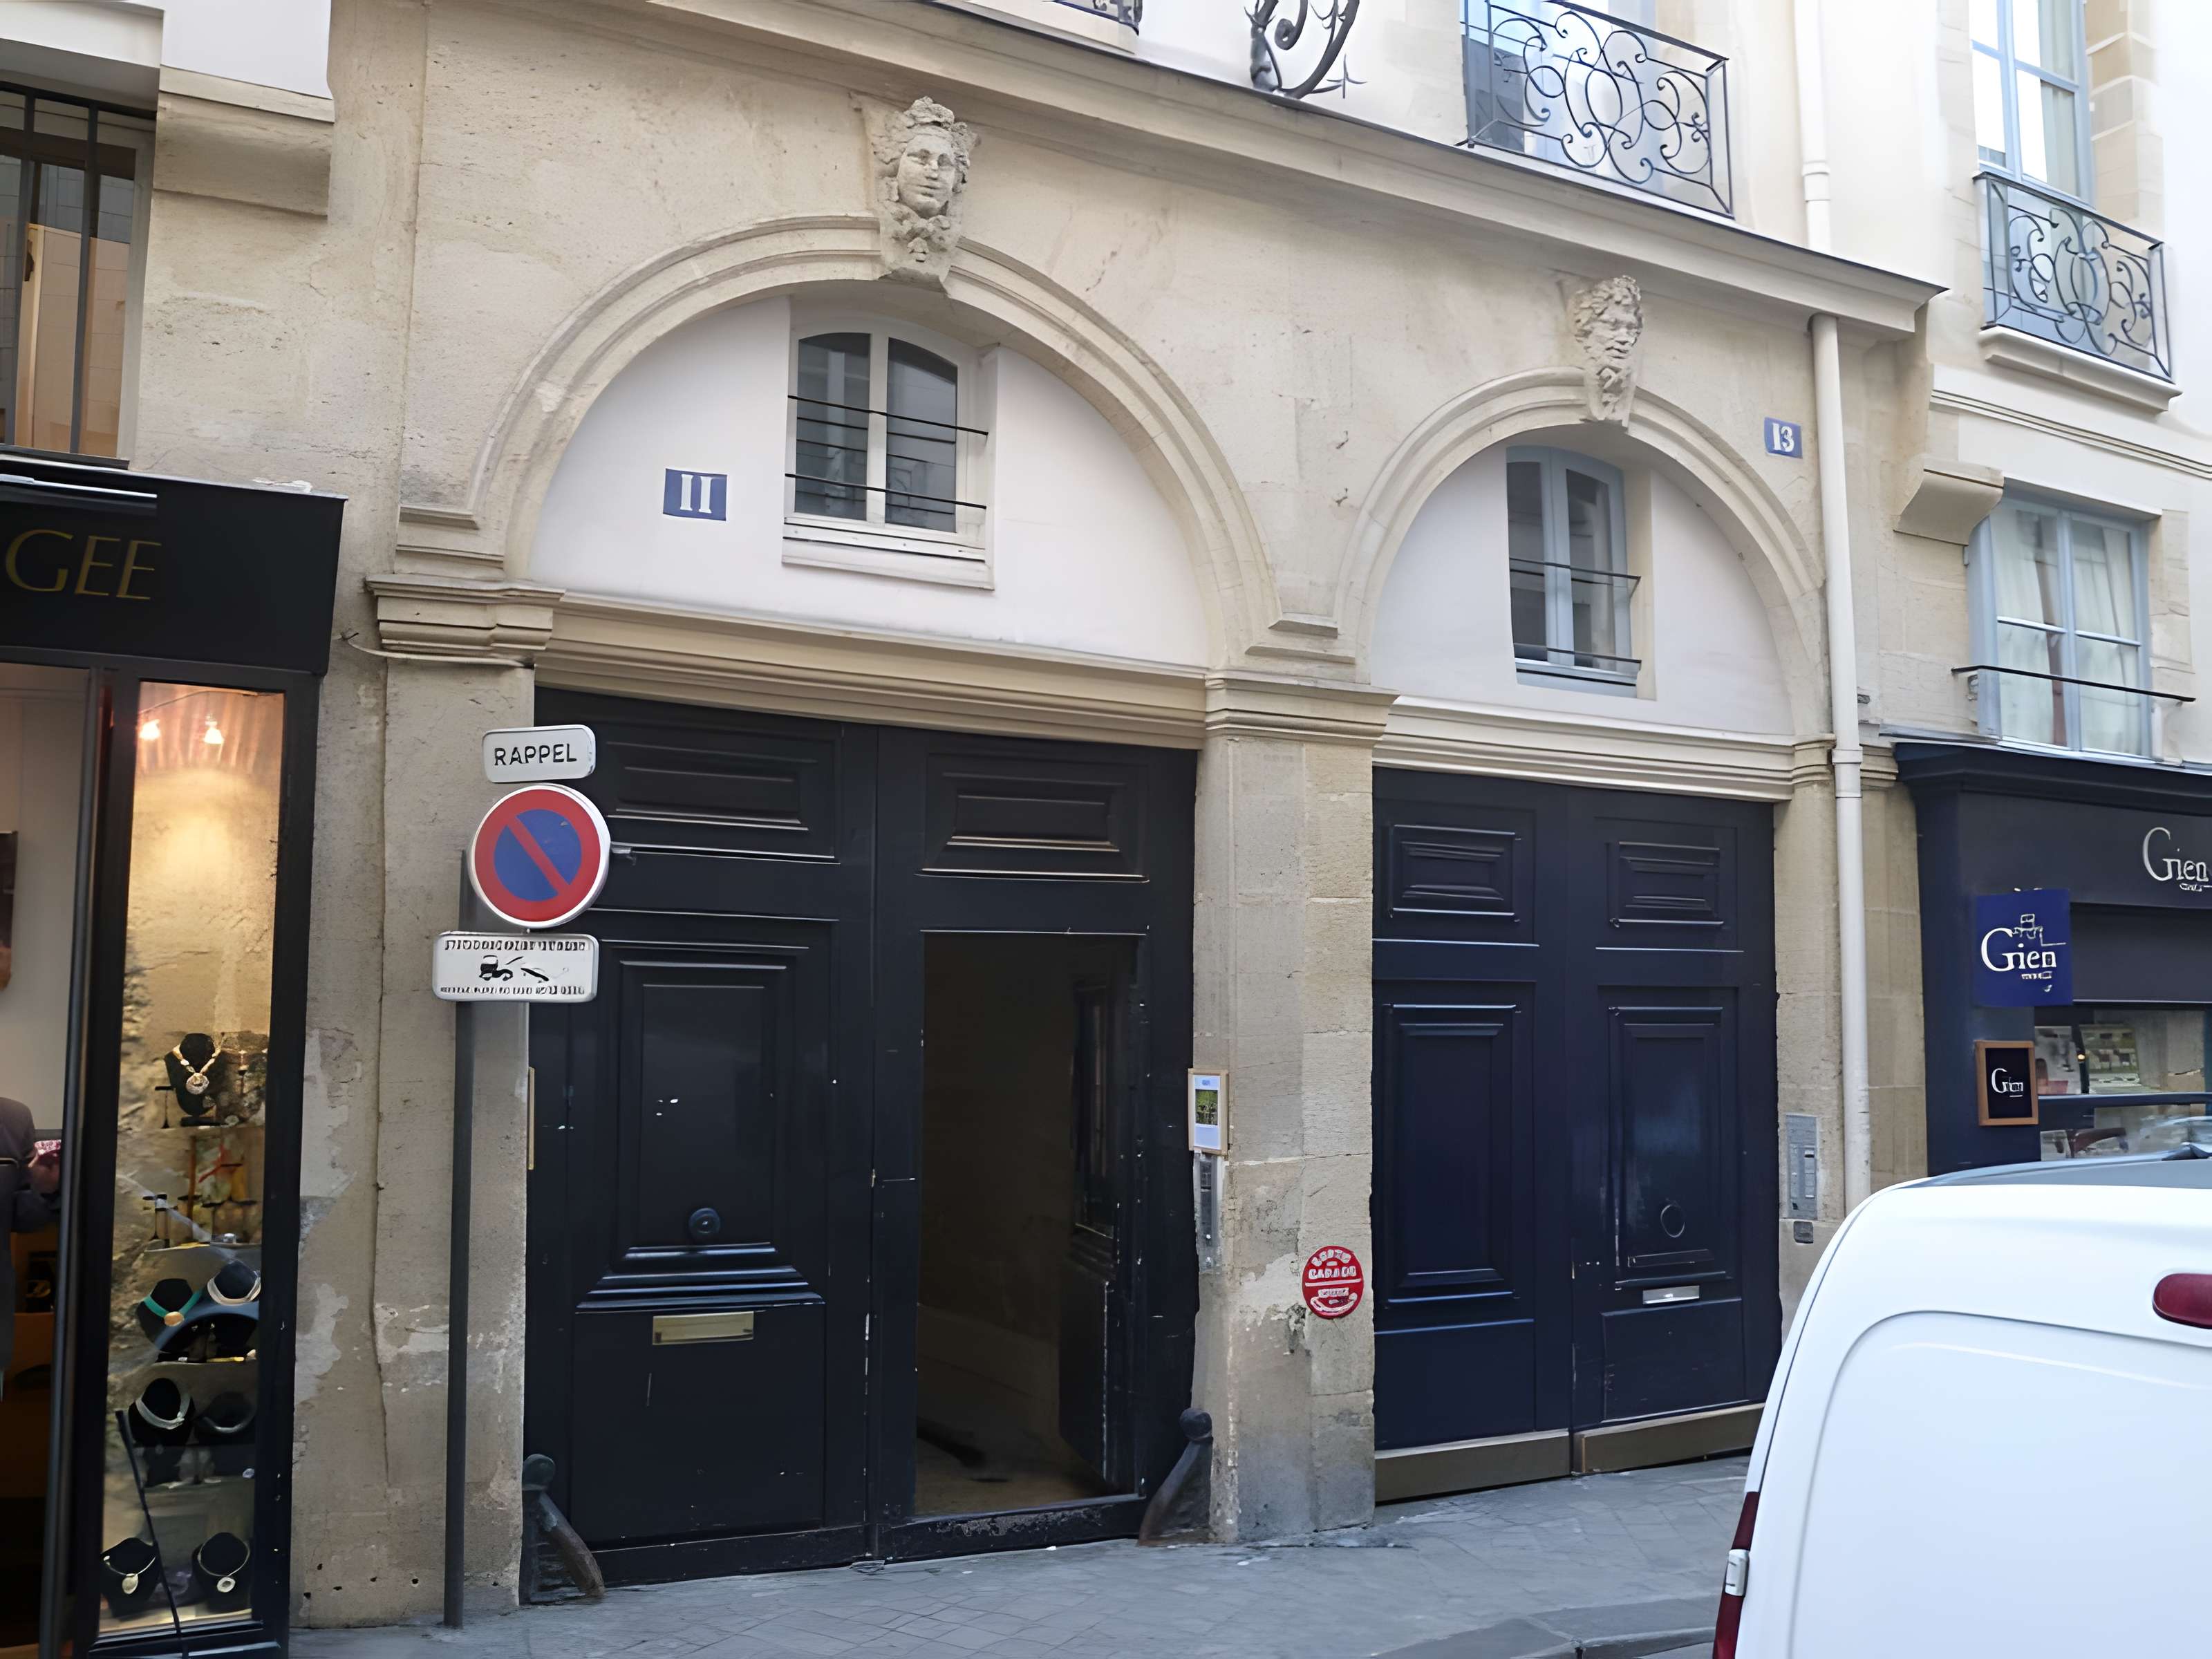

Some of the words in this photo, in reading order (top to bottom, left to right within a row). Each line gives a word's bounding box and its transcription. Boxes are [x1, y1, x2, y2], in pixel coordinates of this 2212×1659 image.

[1772, 422, 1794, 452] 13
[6, 529, 162, 600] GEE
[494, 742, 577, 766] RAPPEL
[2143, 827, 2209, 881] Gien
[1981, 928, 2056, 972] Gien
